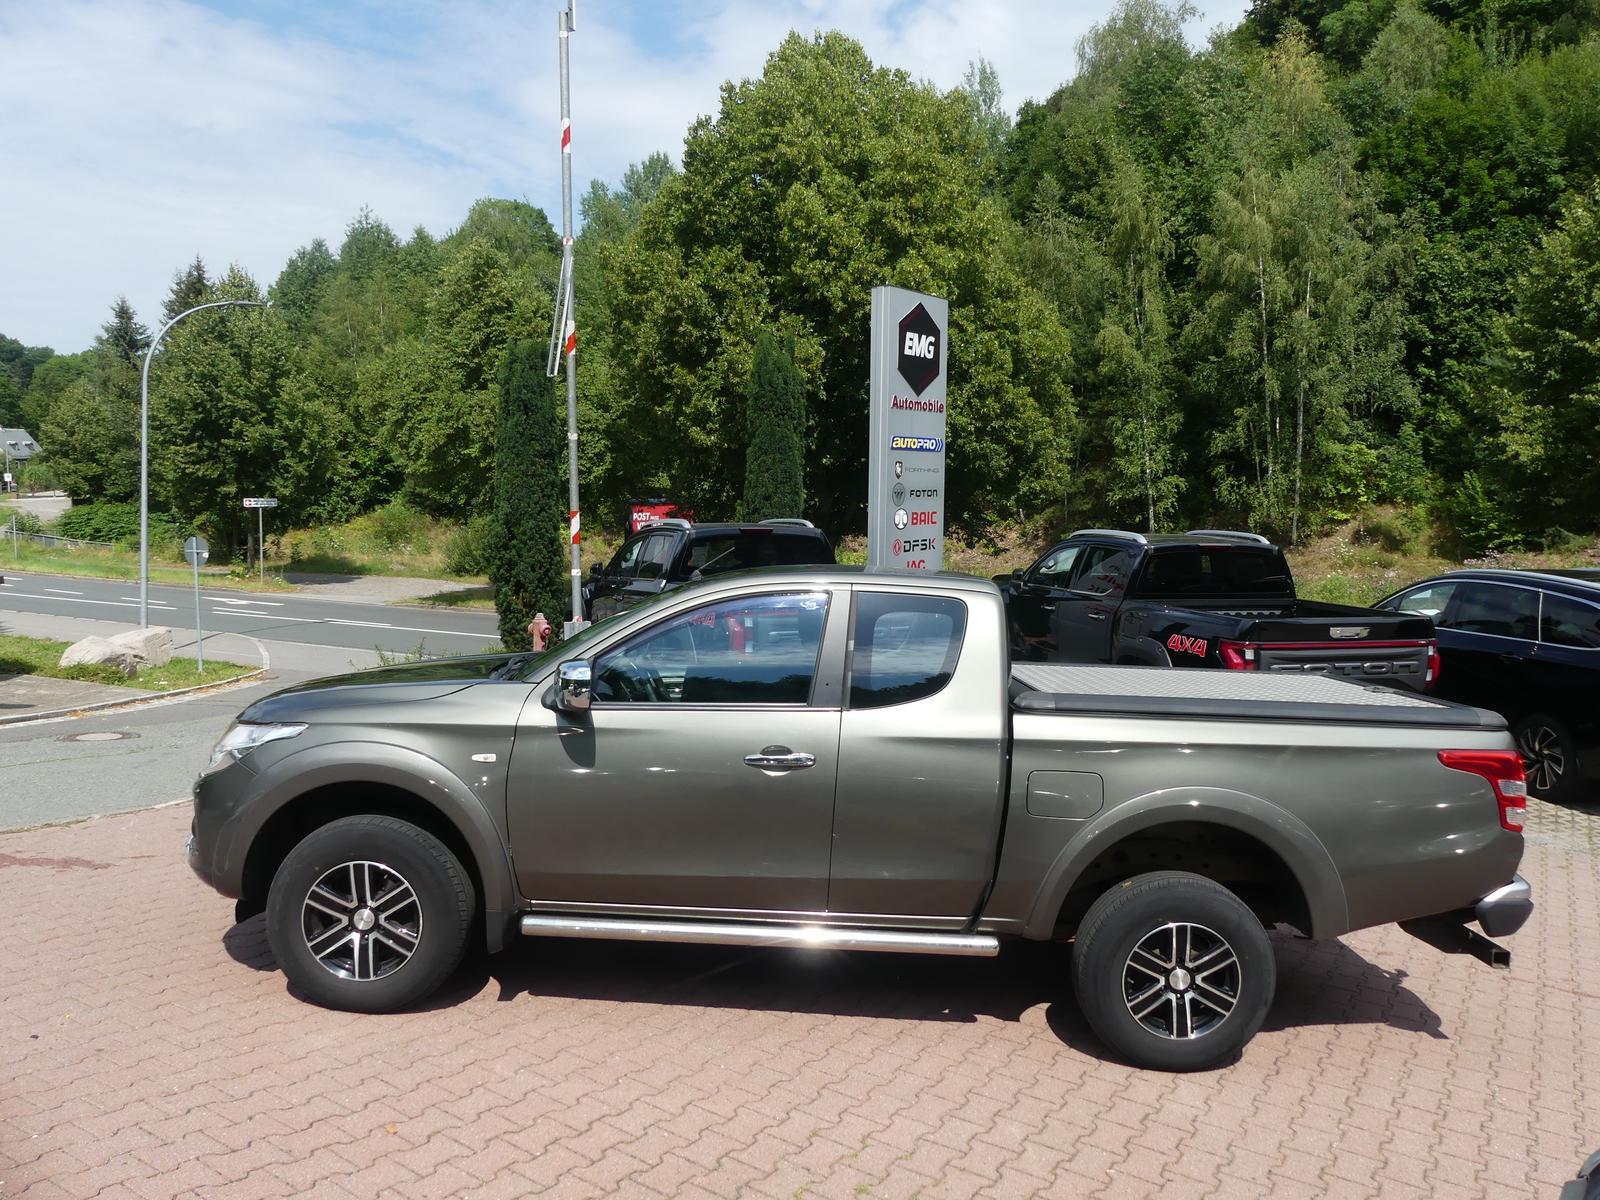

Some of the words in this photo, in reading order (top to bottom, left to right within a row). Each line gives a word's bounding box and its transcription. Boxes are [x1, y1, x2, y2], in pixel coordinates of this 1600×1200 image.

[904, 331, 935, 359] EMG
[891, 395, 944, 413] Automobile
[909, 489, 938, 498] FOTON
[633, 512, 651, 521] POST
[911, 511, 938, 526] BAIC
[903, 538, 936, 553] DFSK
[1167, 633, 1207, 657] 4X4
